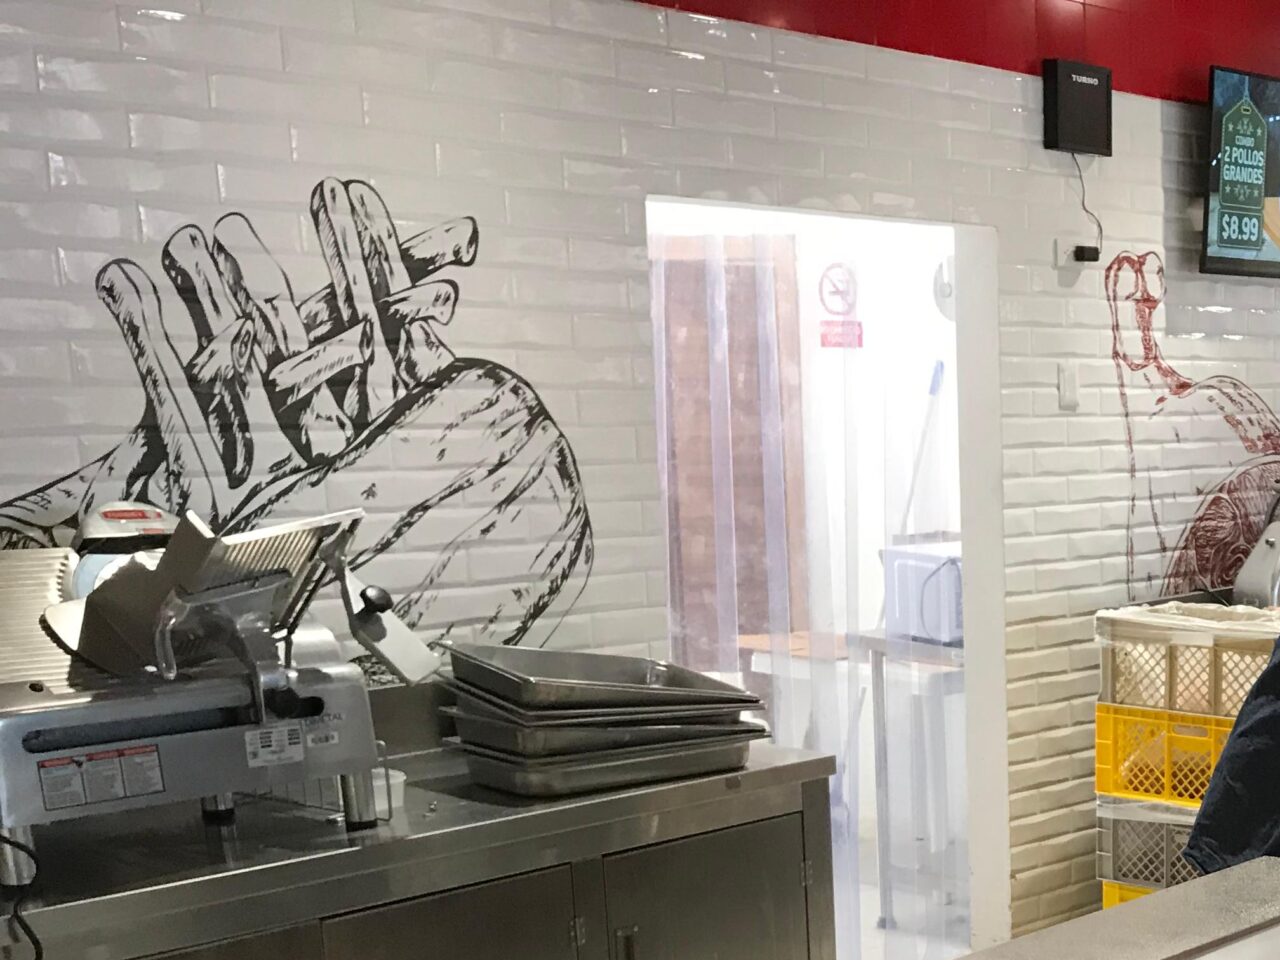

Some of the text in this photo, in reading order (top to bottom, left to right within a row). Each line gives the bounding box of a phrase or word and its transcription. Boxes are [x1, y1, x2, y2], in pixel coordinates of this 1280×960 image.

[1071, 74, 1099, 86] TURNO
[1235, 135, 1255, 148] COMBO
[1224, 147, 1264, 166] 2 POLLOS
[1223, 164, 1264, 185] GRANDES
[1222, 213, 1259, 242] $8.99
